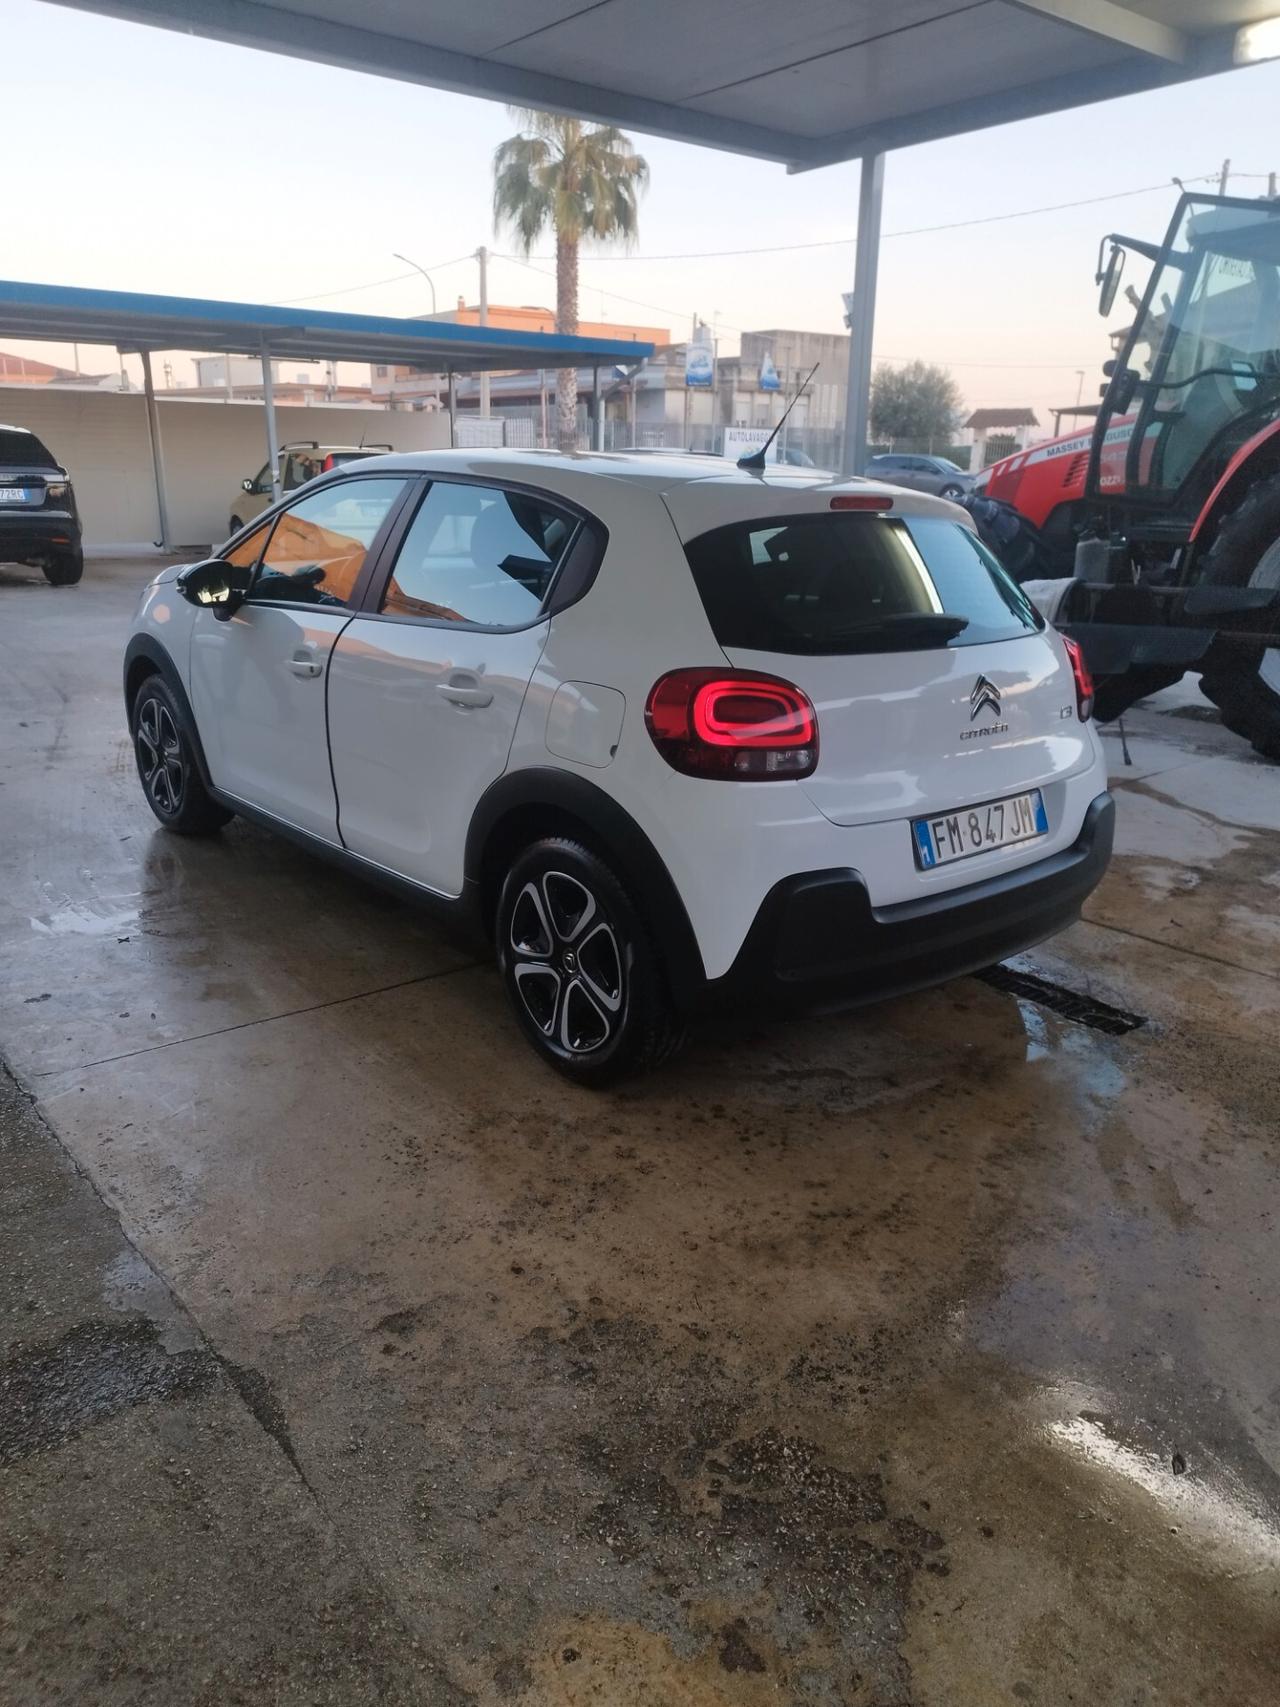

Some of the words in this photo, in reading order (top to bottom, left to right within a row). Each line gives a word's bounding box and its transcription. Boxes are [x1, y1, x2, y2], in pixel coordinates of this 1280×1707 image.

[1047, 441, 1085, 456] MASSEY
[932, 816, 964, 859] FM
[968, 804, 1005, 847] 847
[1011, 797, 1034, 836] JM
